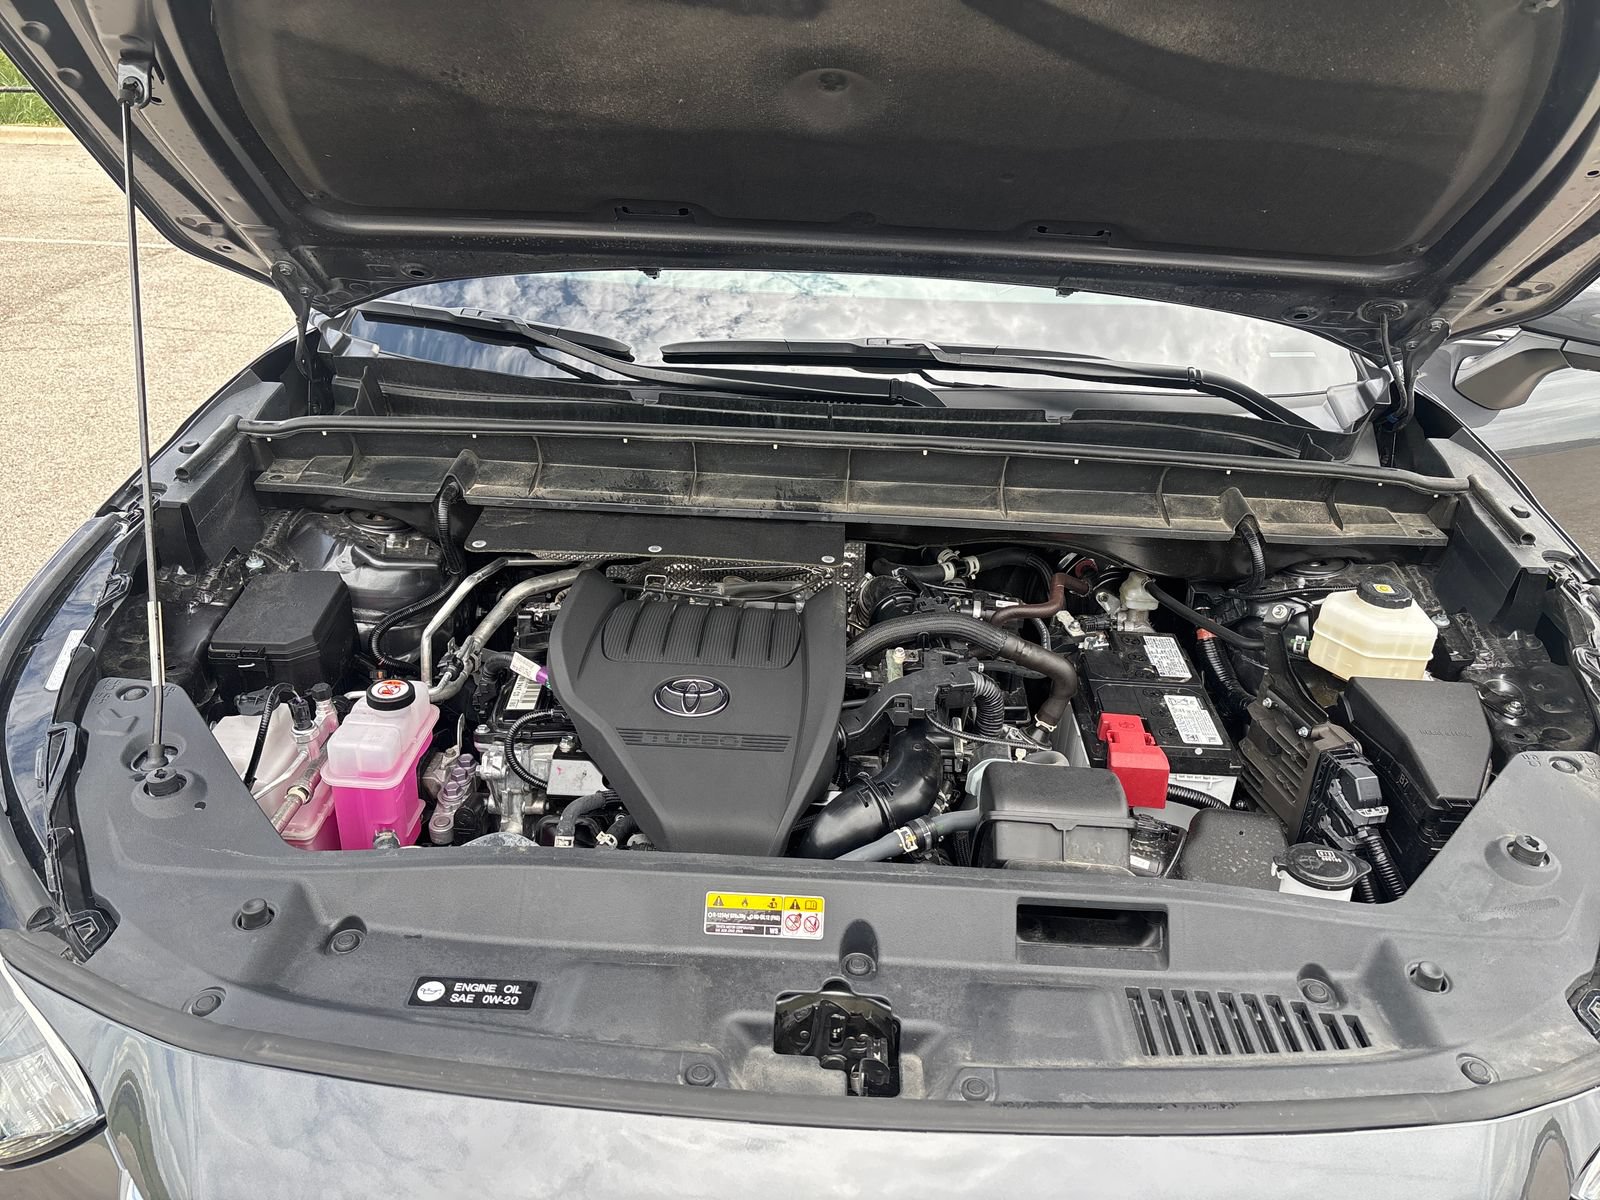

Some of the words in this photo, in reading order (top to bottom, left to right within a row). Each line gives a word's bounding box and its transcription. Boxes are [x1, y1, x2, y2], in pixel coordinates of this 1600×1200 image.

[642, 731, 742, 747] TURBO
[453, 983, 498, 993] ENGINE
[503, 985, 523, 994] OIL
[449, 993, 476, 1003] SAE
[482, 995, 519, 1005] 0W-20
